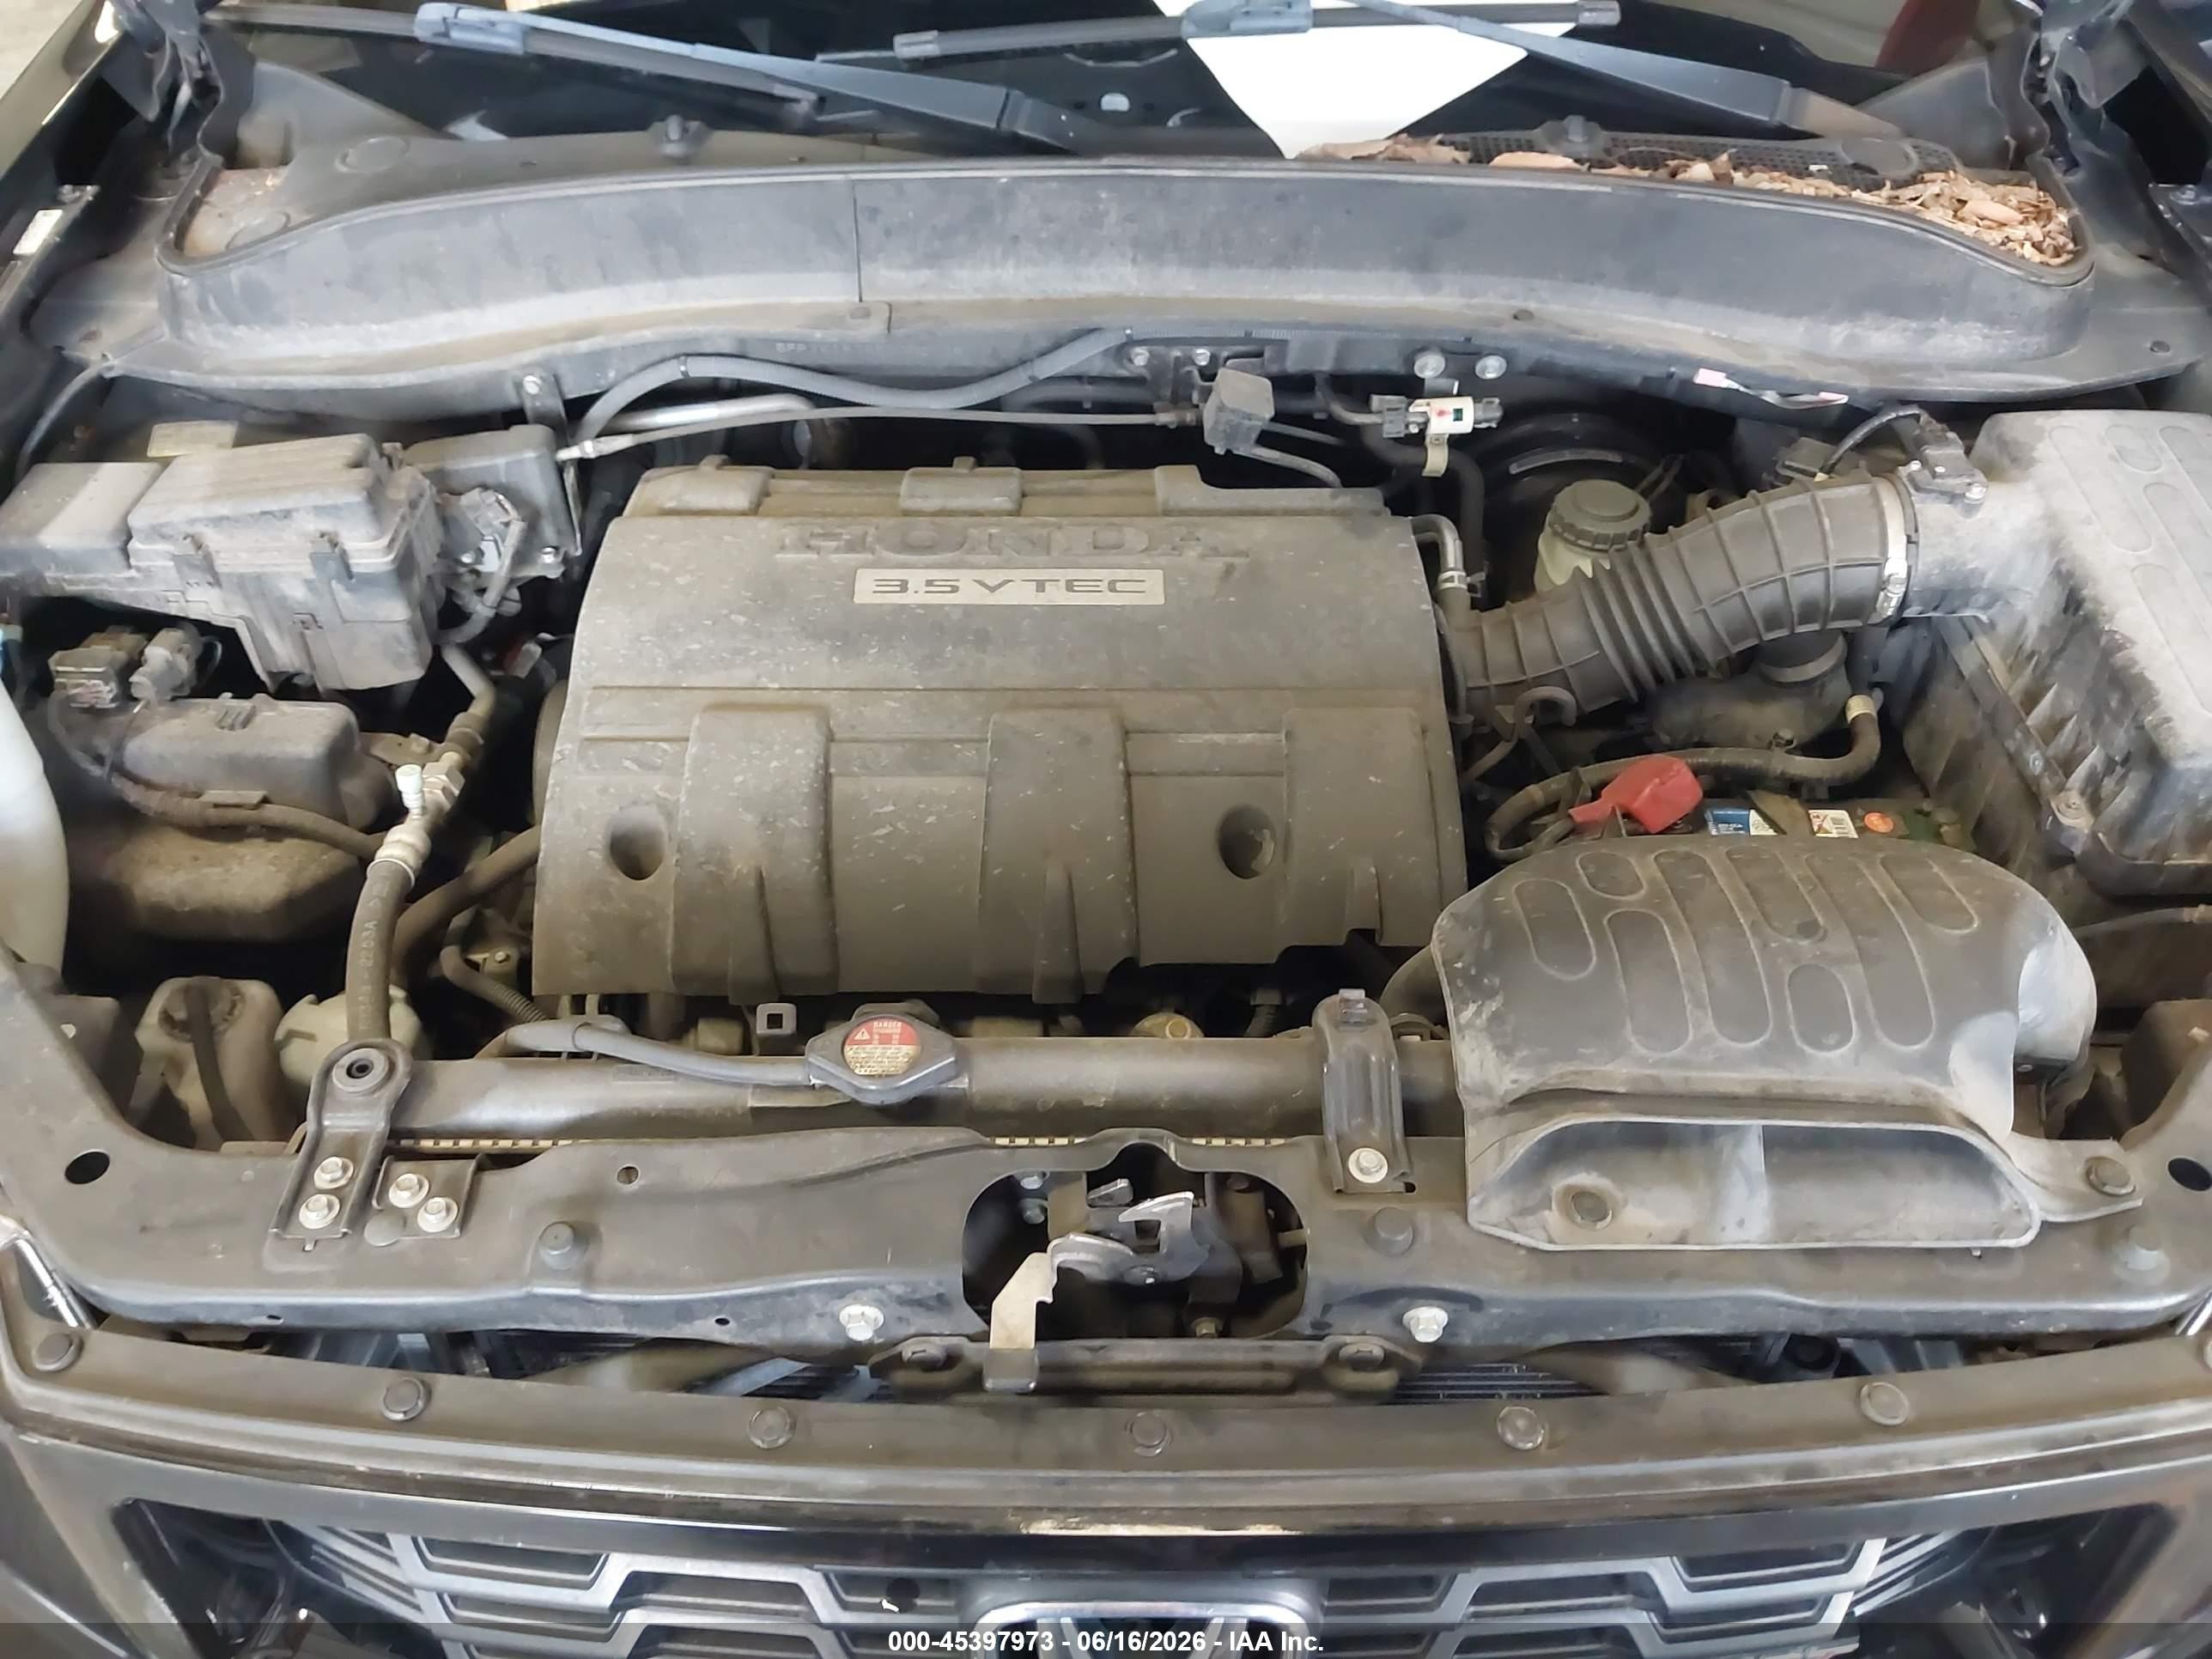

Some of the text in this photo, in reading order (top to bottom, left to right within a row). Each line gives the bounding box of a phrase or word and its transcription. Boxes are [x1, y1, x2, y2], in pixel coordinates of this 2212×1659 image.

[775, 523, 1250, 559] HONDA
[872, 579, 1147, 594] 3.5 VTEC
